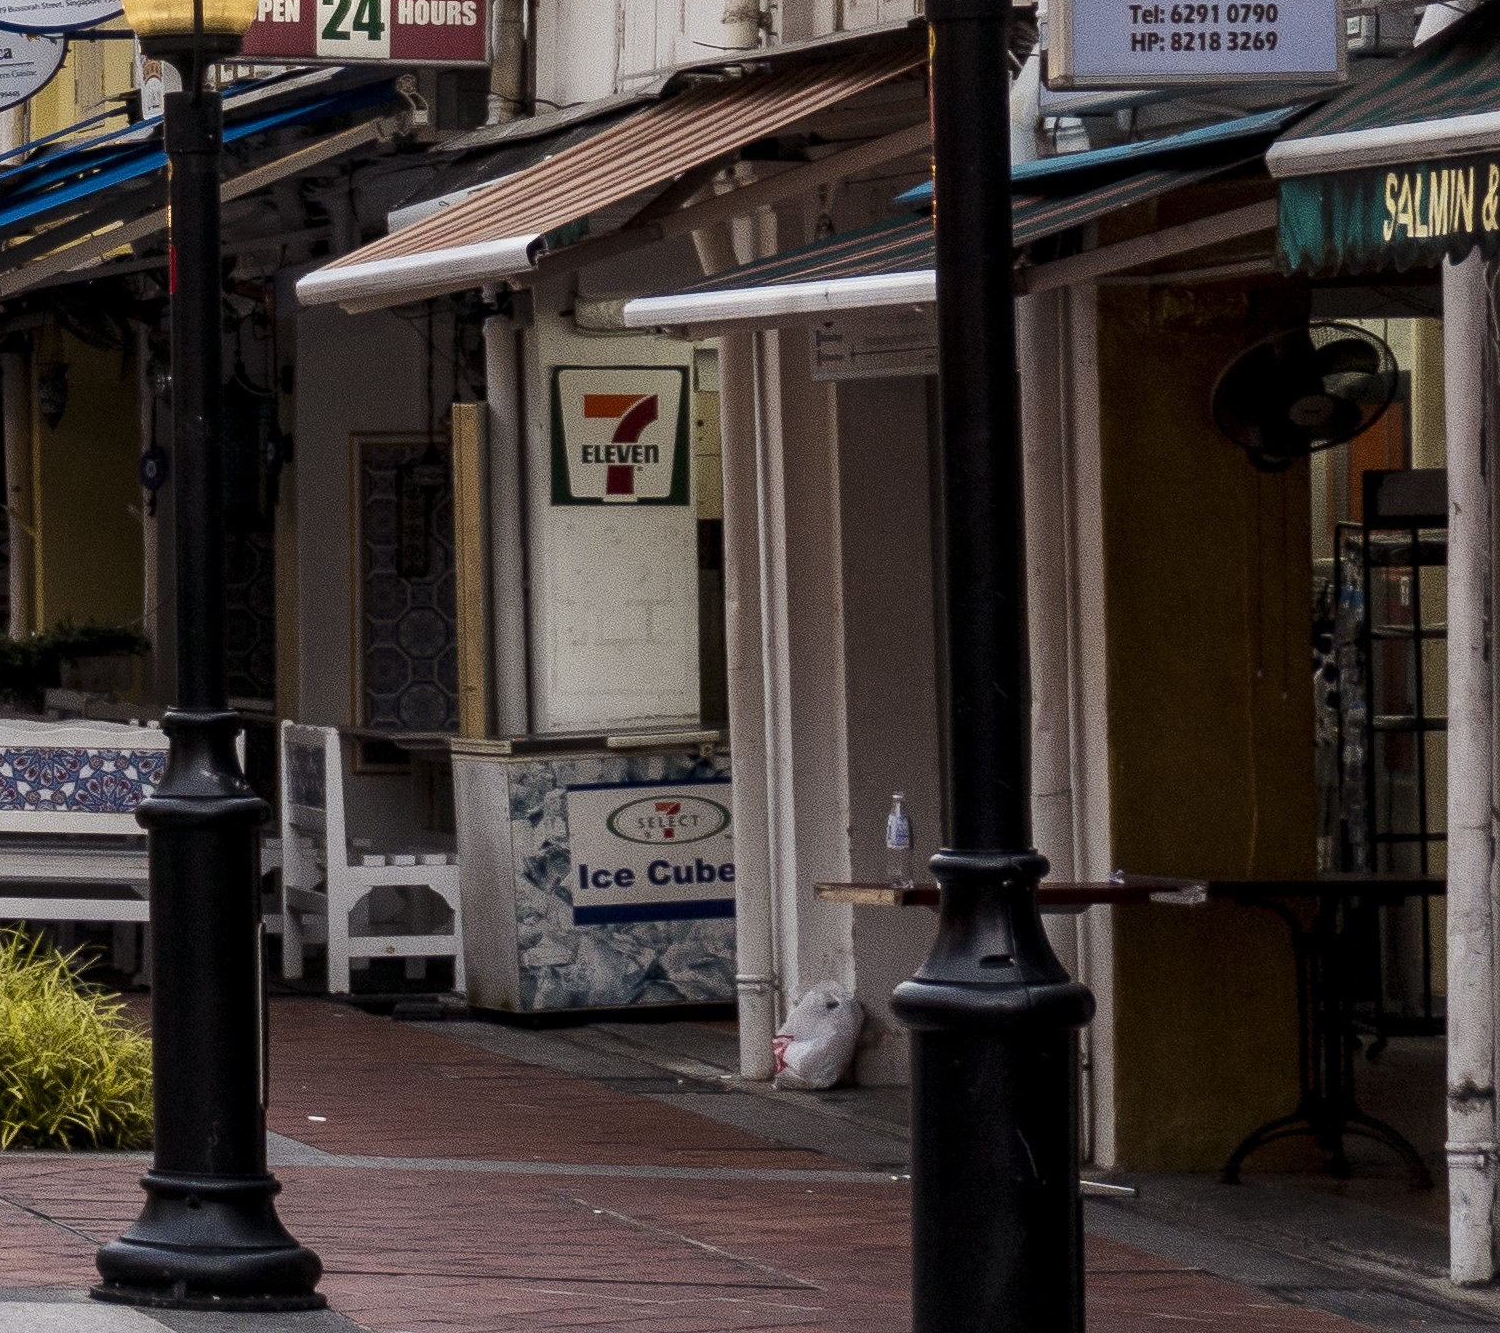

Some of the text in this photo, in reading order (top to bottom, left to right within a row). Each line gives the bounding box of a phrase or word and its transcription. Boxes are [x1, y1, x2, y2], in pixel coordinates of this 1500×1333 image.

[8, 3, 40, 13] Bussorah
[1129, 2, 1279, 25] Tel: 6291 0790
[1131, 31, 1279, 52] HP: 8218 3269
[11, 69, 37, 79] Cuisine
[1383, 162, 1500, 241] SALMIN &
[582, 393, 658, 495] 7
[638, 814, 700, 829] SELECT
[578, 857, 736, 890] Ice Cube
